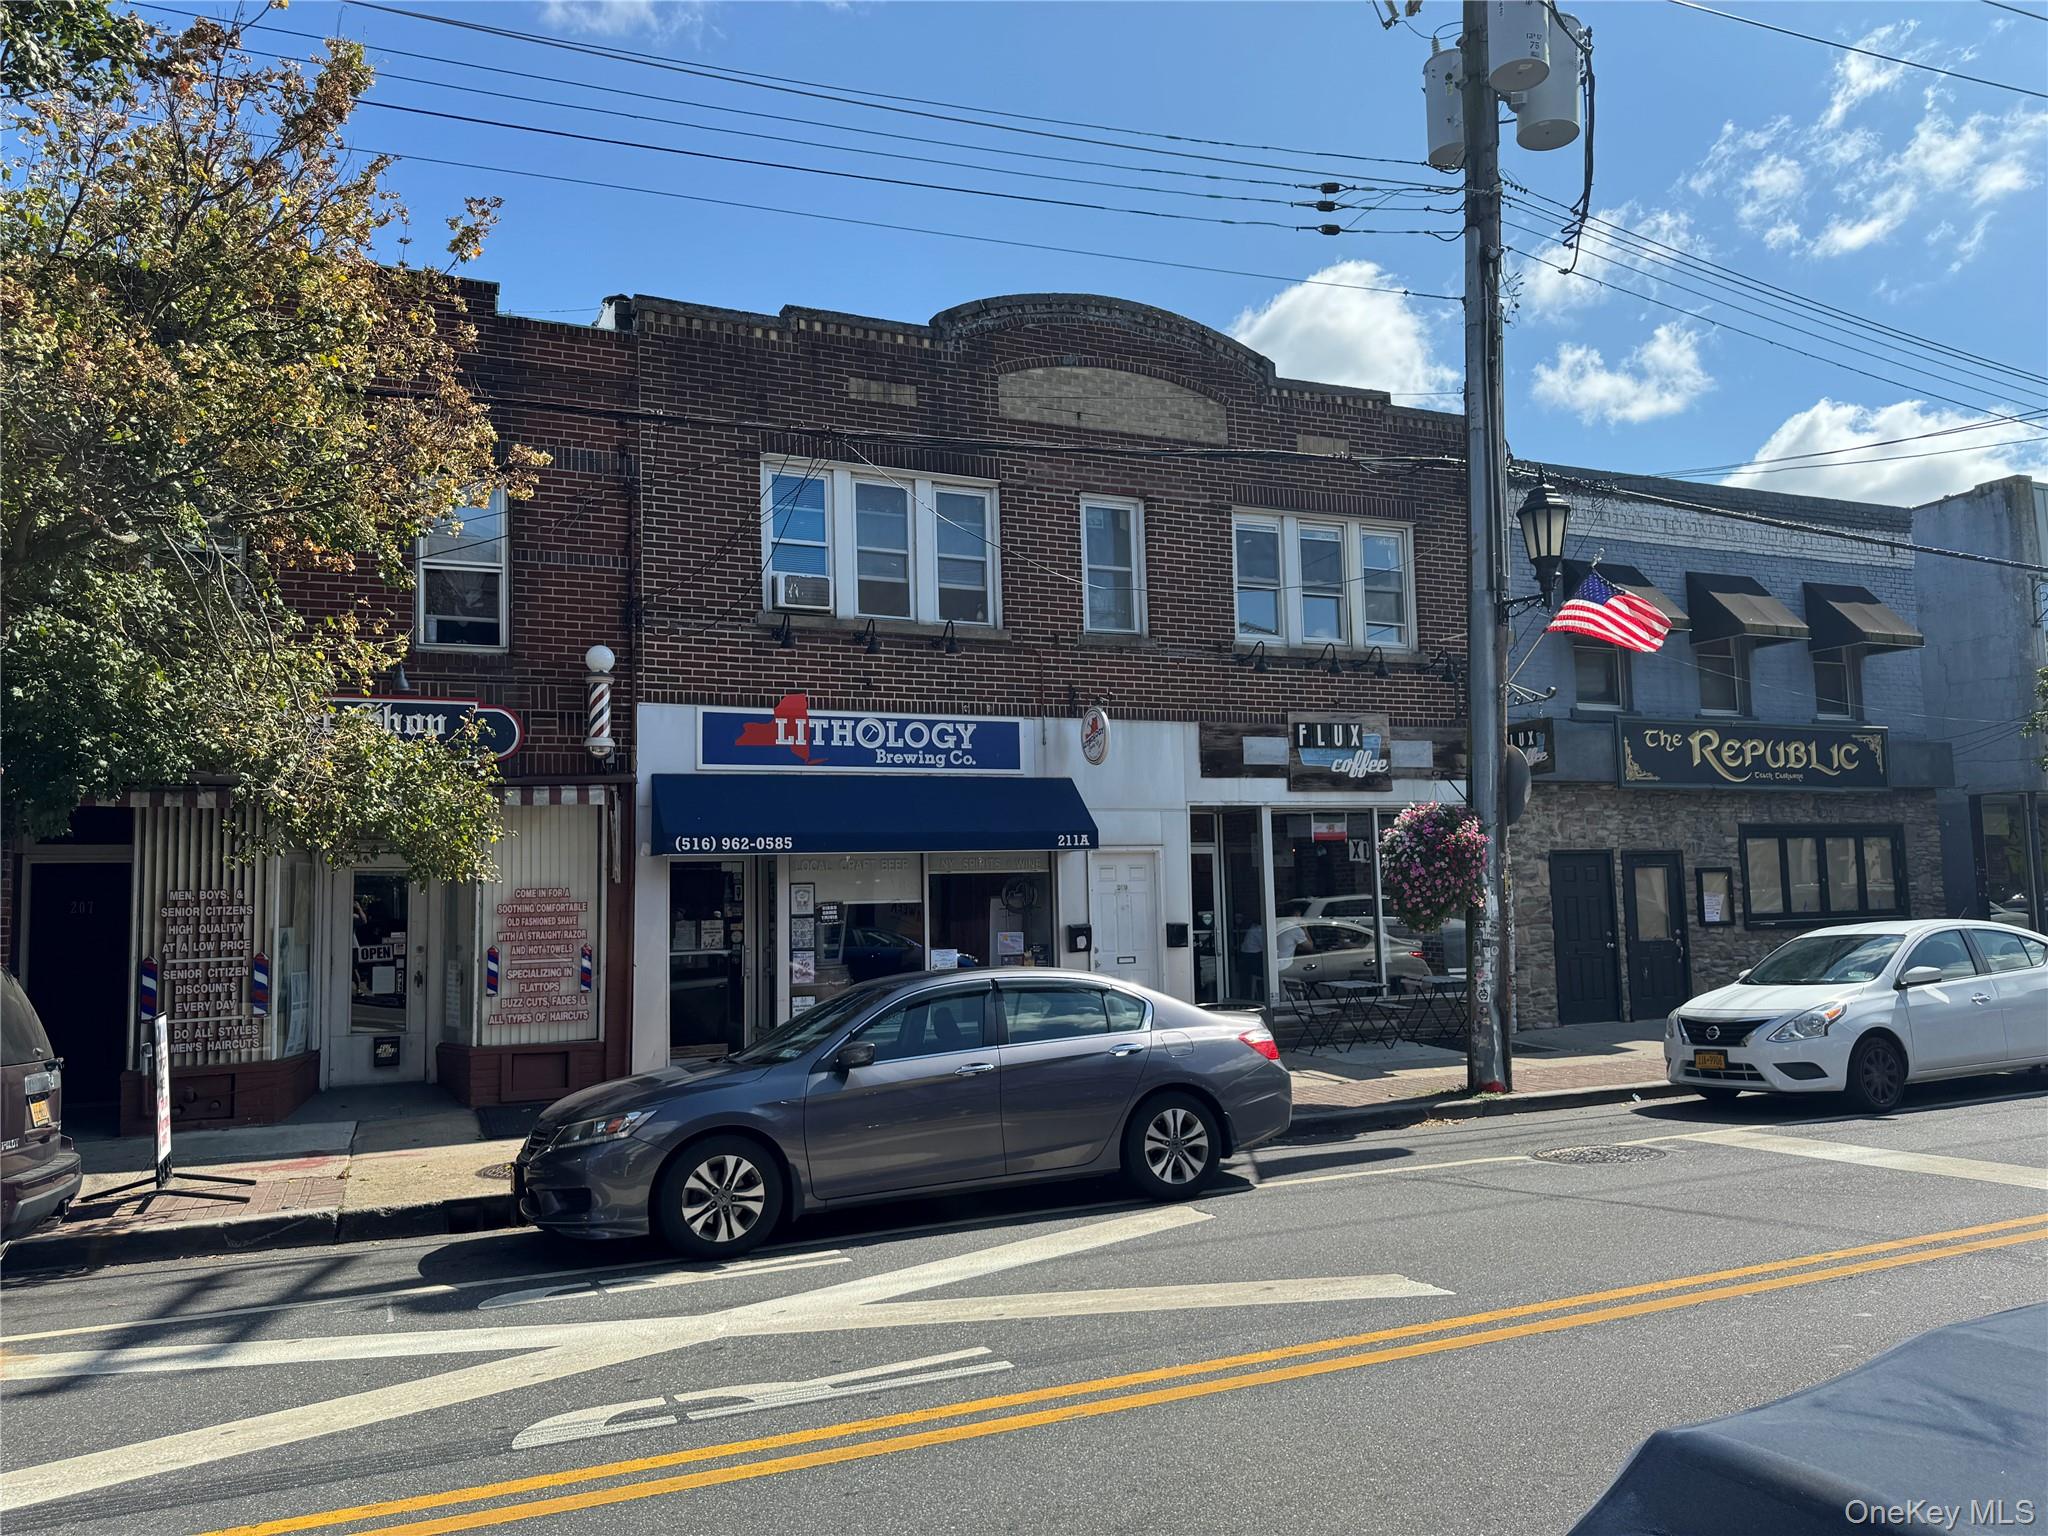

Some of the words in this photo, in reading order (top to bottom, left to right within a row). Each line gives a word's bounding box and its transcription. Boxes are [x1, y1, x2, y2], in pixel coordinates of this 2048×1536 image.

[775, 717, 977, 749] LITHOLOGY
[1298, 724, 1360, 746] FLUX
[1643, 729, 1683, 751] The
[875, 748, 946, 767] Brewing
[950, 750, 977, 765] Co.
[1331, 750, 1389, 778] coffee
[675, 836, 717, 851] (516)
[721, 836, 793, 850] 962-0585
[1058, 834, 1090, 846] 211A
[169, 891, 195, 901] MEN,
[200, 890, 230, 900] BOYS,
[236, 889, 244, 899] &
[515, 889, 537, 898] COME
[539, 889, 546, 897] IN
[548, 888, 563, 897] FOR
[563, 888, 571, 897] A
[69, 901, 94, 914] 207
[161, 907, 200, 917] SENIOR
[205, 906, 253, 916] CITIZENS
[497, 904, 535, 914] SOOTHING
[536, 902, 587, 912] COMFORTABLE
[507, 918, 520, 927] OLD
[521, 917, 556, 926] FASHIONED
[558, 915, 577, 925] SHAVE
[168, 925, 193, 935] HIGH
[199, 923, 244, 934] QUALITY
[497, 932, 516, 941] WITH
[518, 932, 525, 940] A
[527, 931, 562, 940] STRAIGHT
[564, 930, 587, 939] RAZOR
[162, 943, 175, 953] AT
[180, 943, 188, 952] A
[193, 941, 215, 951] LOW
[220, 940, 251, 950] PRICE
[511, 946, 526, 955] AND
[528, 945, 542, 954] HOT
[546, 944, 574, 954] TOWELS
[361, 946, 391, 960] OPEN
[163, 969, 202, 980] SENIOR
[207, 967, 249, 977] CITIZEN
[507, 968, 562, 979] SPECIALIZING
[564, 968, 573, 976] IN
[175, 982, 237, 994] DISCOUNTS
[519, 982, 560, 992] FLATTOPS
[176, 1001, 211, 1012] EVERY
[216, 1000, 236, 1010] DAY
[501, 998, 523, 1008] BUZZ
[526, 997, 551, 1007] CUTS,
[552, 996, 577, 1005] FADES
[488, 1015, 504, 1025] ALL
[507, 1014, 533, 1023] TYPES
[535, 1013, 547, 1022] OF
[550, 1011, 589, 1021] HAIRCUTS
[174, 1029, 189, 1039] DO
[195, 1028, 213, 1038] ALL
[218, 1025, 259, 1036] STYLES
[170, 1043, 202, 1053] MEN'S
[207, 1039, 260, 1051] HAIRCUTS
